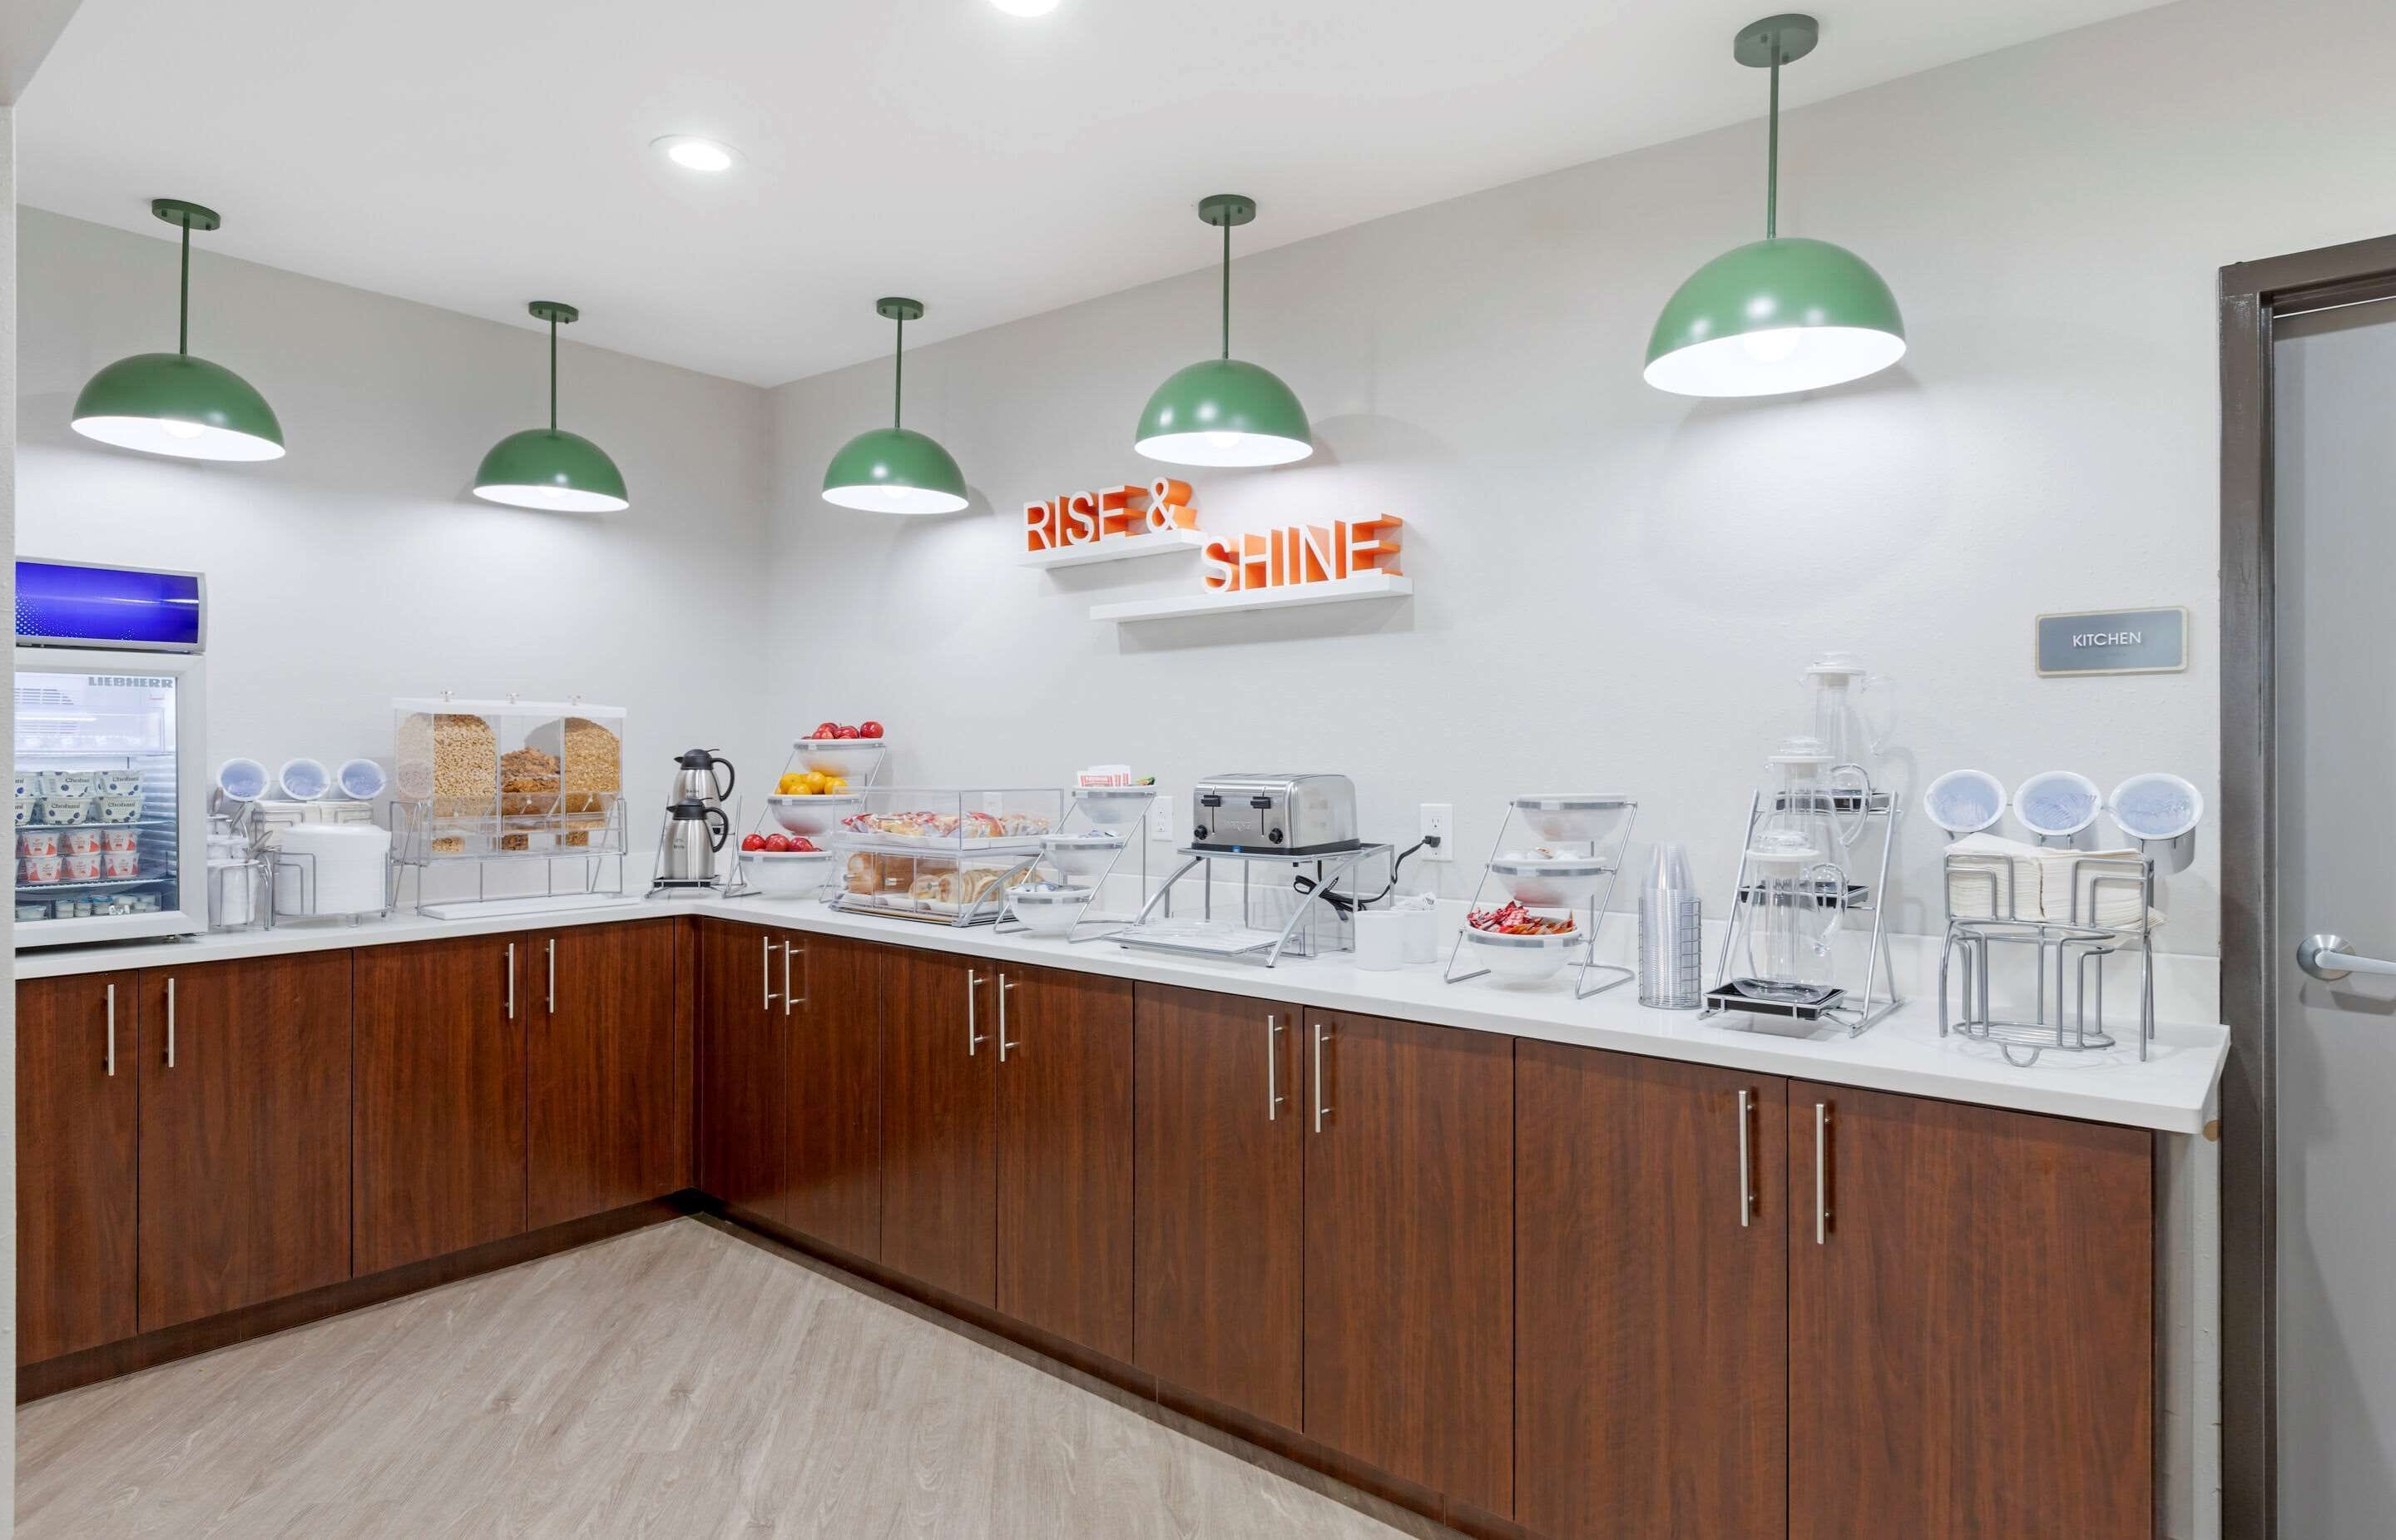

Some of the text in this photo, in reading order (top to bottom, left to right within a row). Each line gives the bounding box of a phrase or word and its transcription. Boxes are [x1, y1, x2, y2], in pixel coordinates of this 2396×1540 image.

[1023, 476, 1185, 552] RISE &
[1200, 517, 1386, 594] SHINE
[2072, 631, 2142, 646] KITCHEN
[88, 676, 173, 688] LIEBHERR
